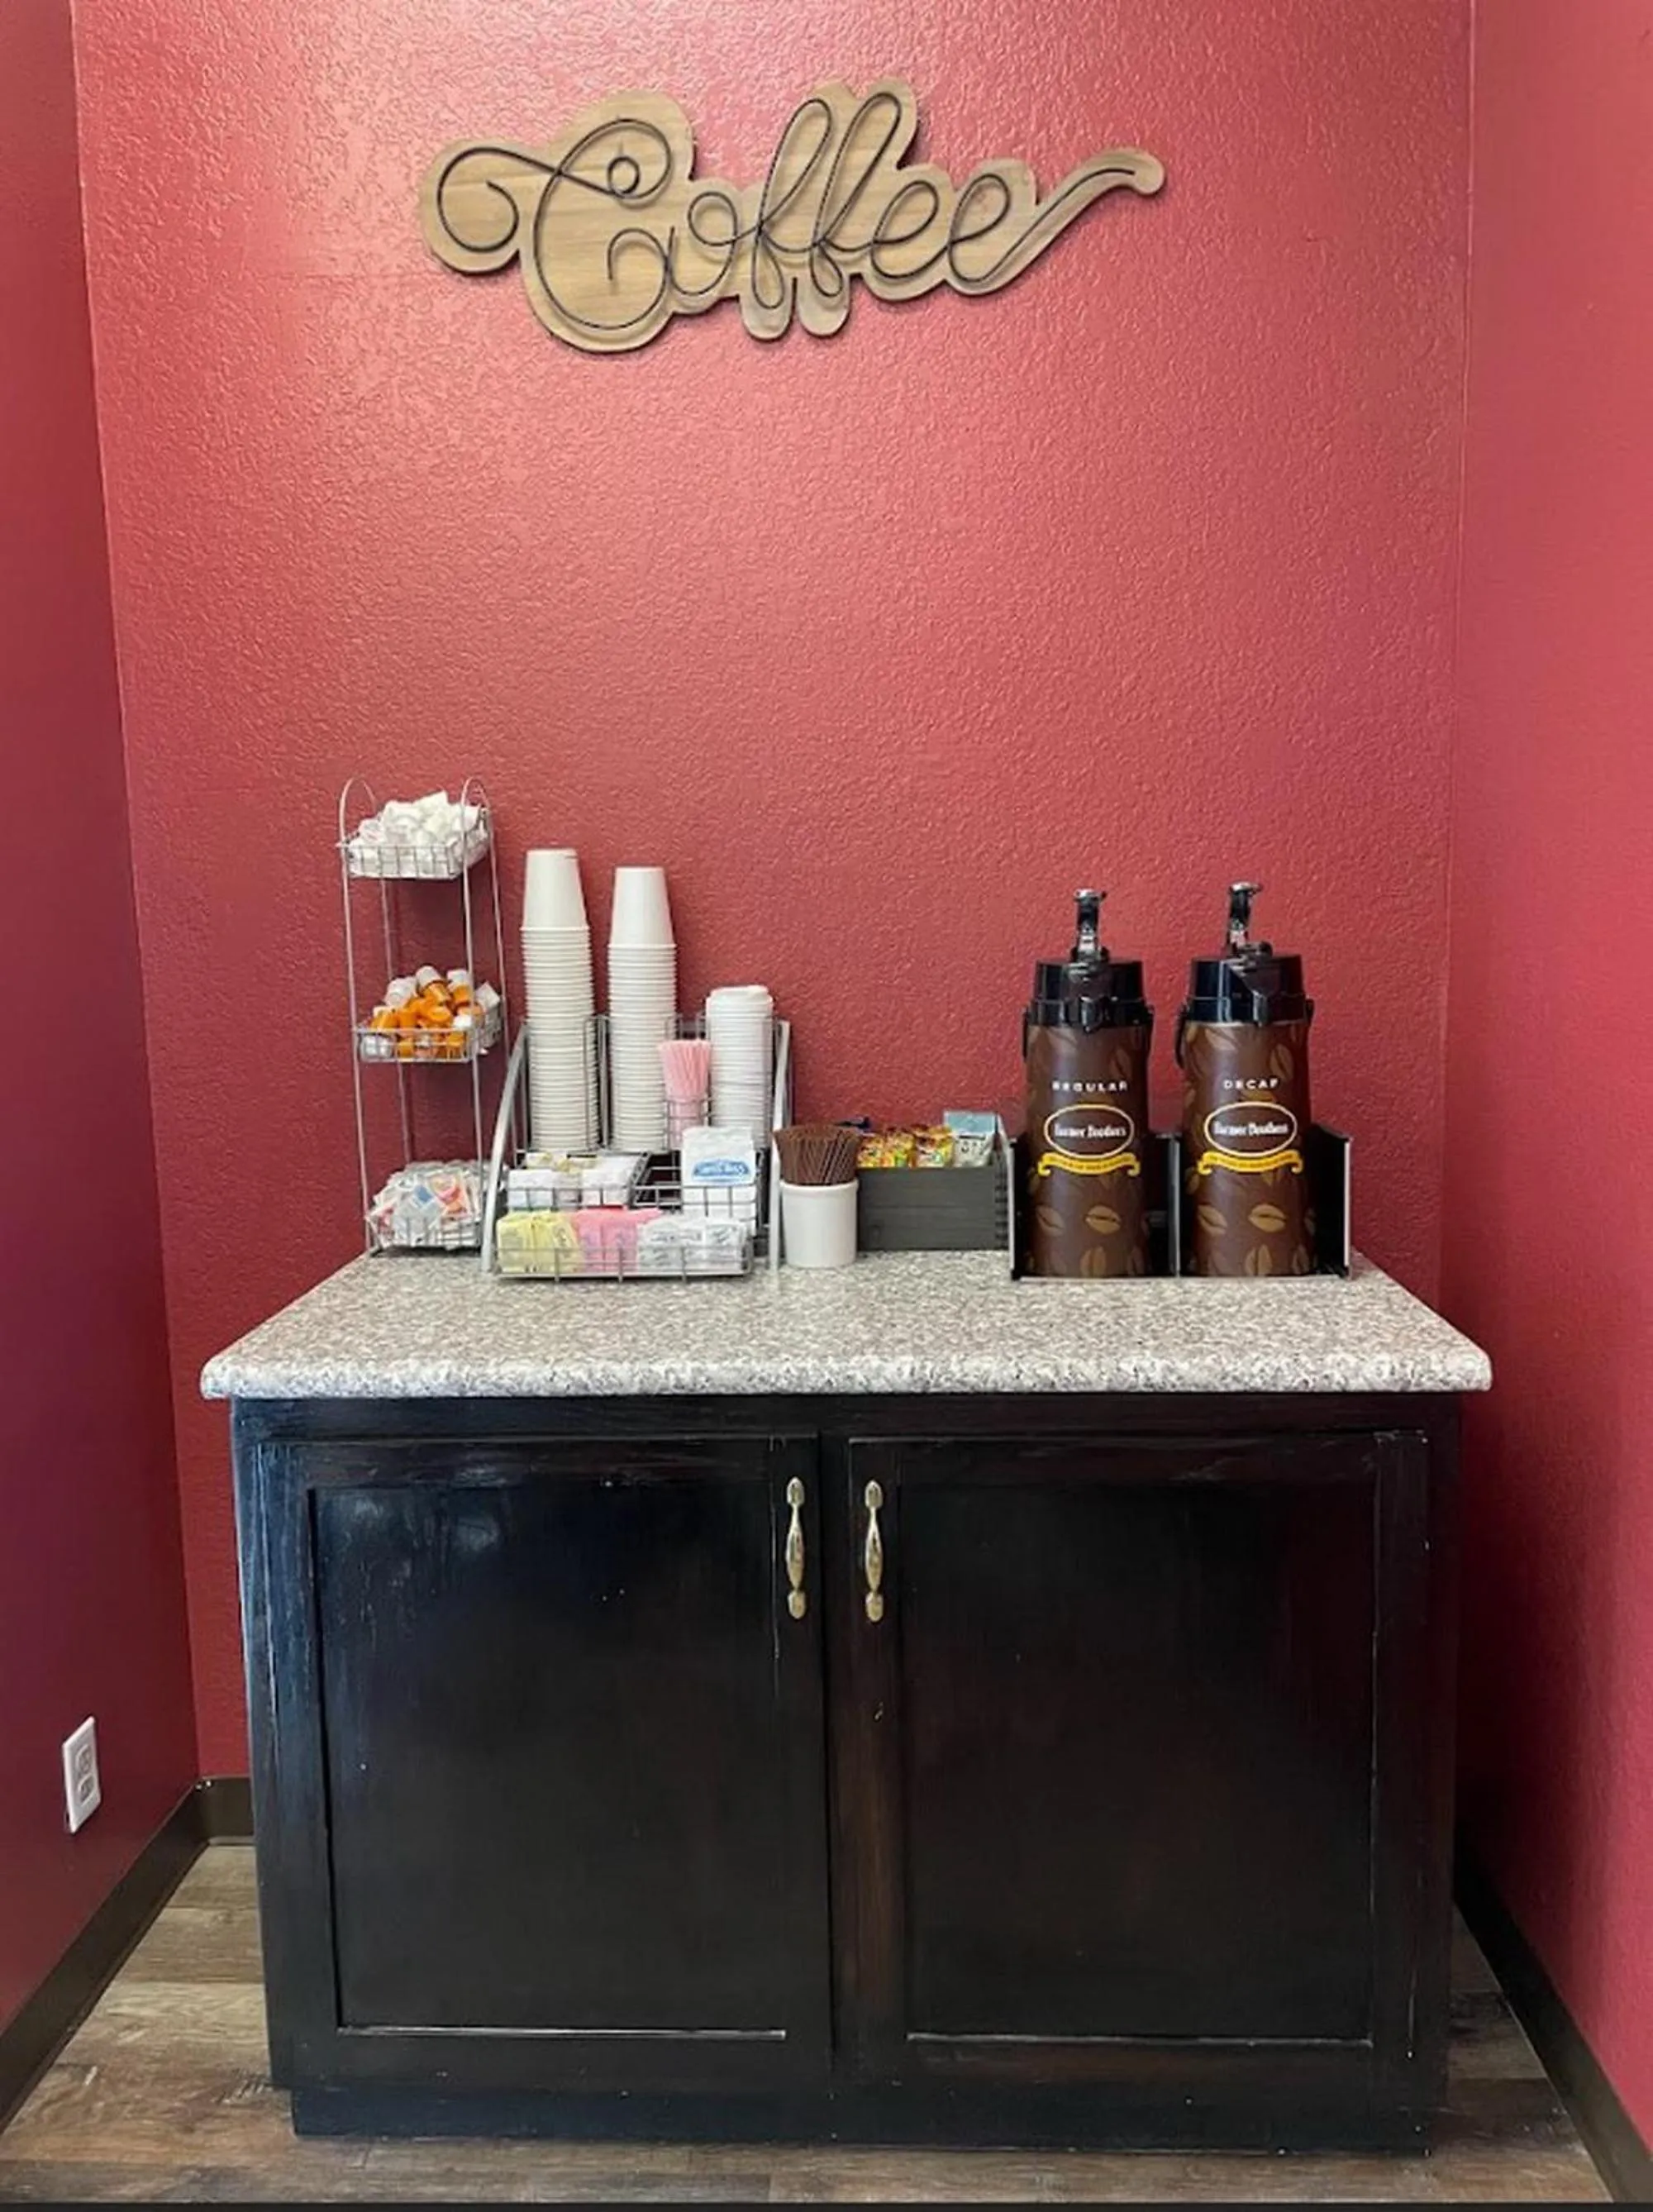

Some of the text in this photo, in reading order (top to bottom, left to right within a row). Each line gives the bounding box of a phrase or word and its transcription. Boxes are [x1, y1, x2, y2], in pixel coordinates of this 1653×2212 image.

[438, 91, 1136, 331] Coffee
[1052, 1080, 1128, 1092] REGULAR
[1223, 1078, 1279, 1089] DECAF
